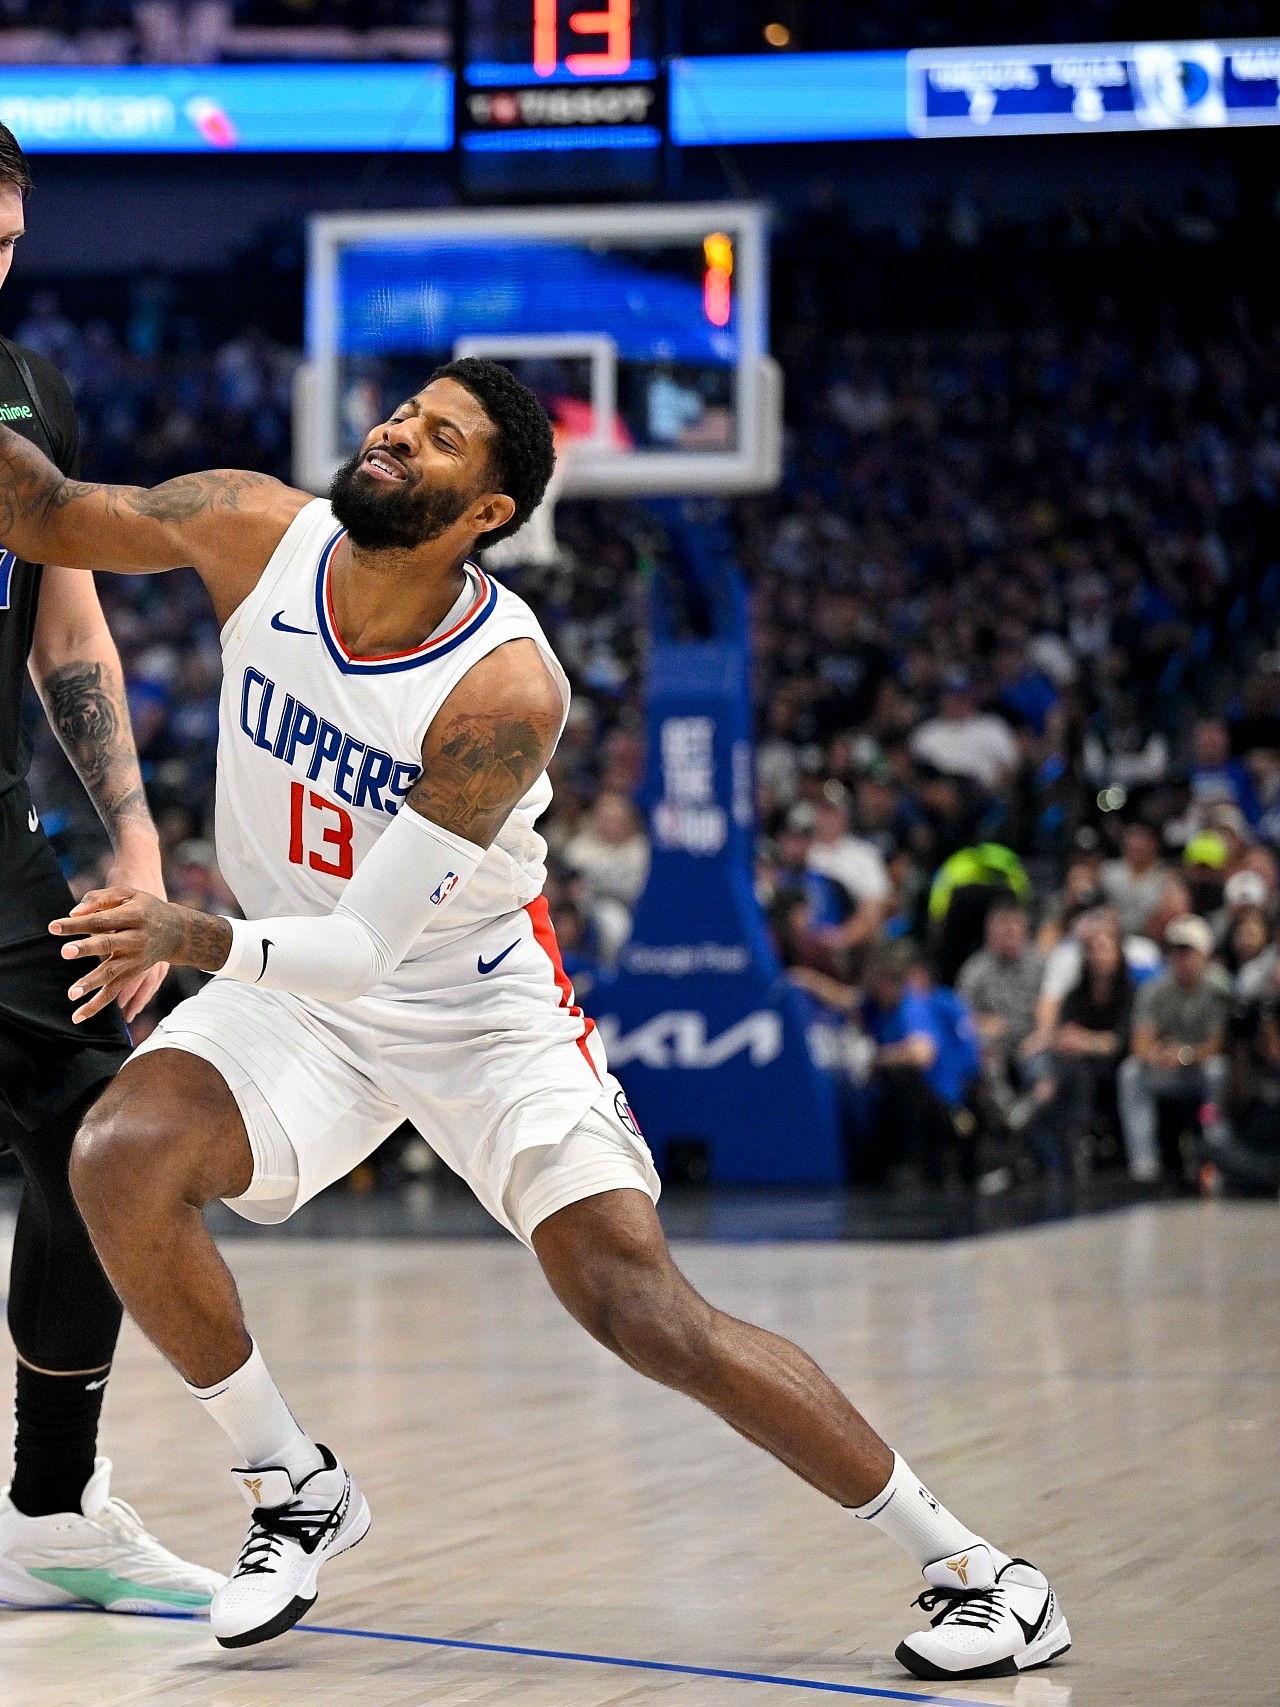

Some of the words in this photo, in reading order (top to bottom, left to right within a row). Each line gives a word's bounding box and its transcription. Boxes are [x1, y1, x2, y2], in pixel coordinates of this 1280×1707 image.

[533, 0, 631, 77] 13
[240, 666, 424, 816] CLIPPERS
[288, 781, 354, 881] 13
